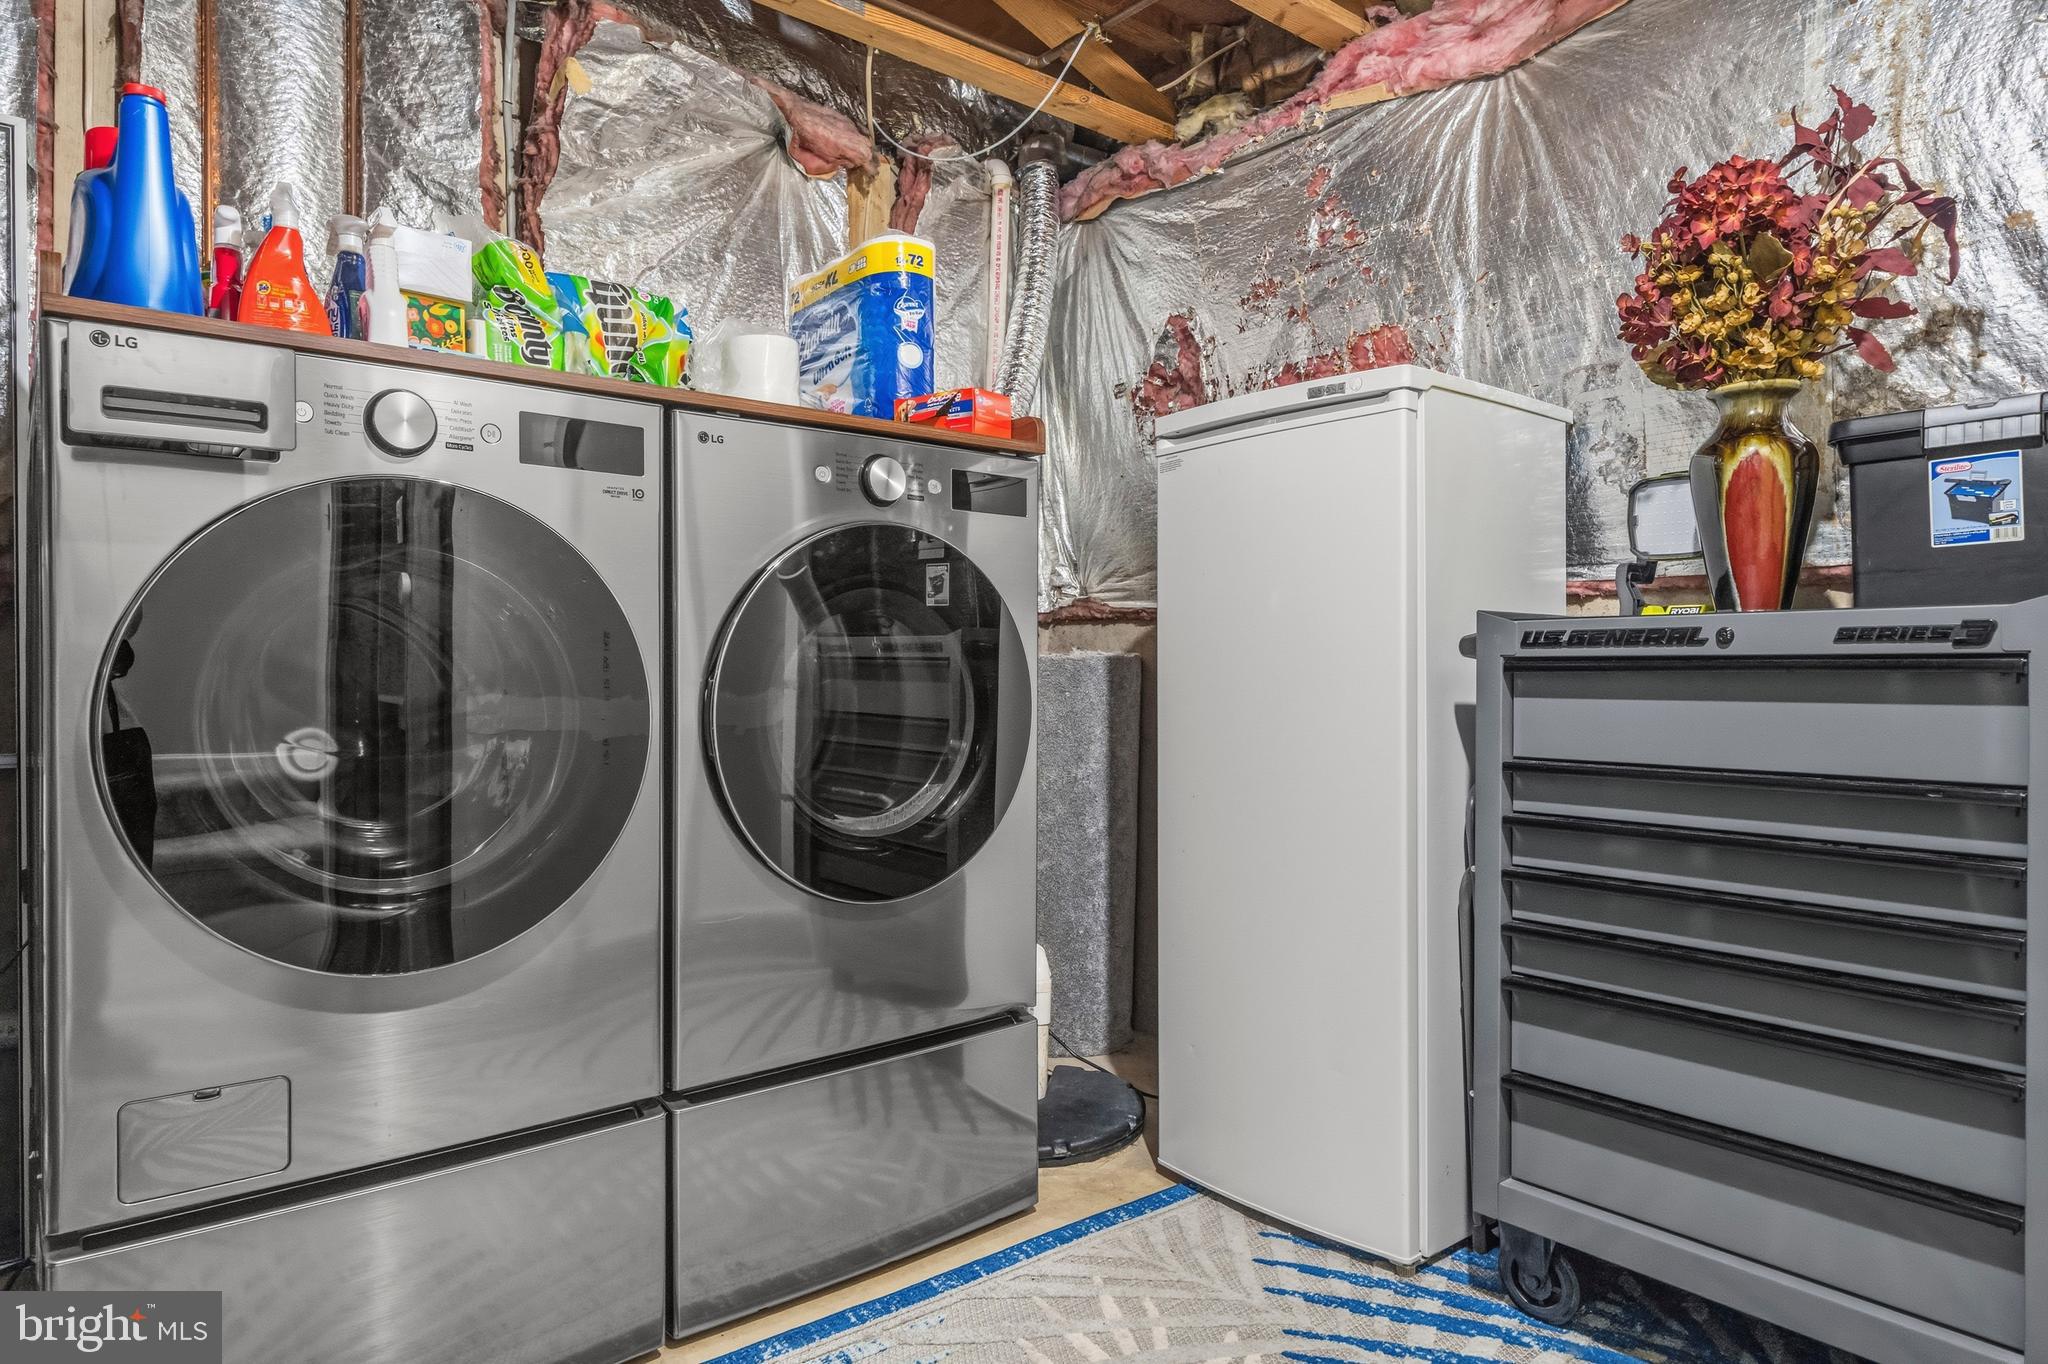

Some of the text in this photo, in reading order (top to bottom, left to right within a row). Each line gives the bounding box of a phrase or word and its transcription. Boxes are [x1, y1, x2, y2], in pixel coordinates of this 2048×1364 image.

[908, 254, 924, 267] 72
[114, 334, 139, 349] LG
[711, 434, 724, 444] LG
[1671, 607, 1700, 615] RYOBI
[1567, 627, 1709, 649] GENERAL
[1833, 618, 1999, 650] SERIES 3
